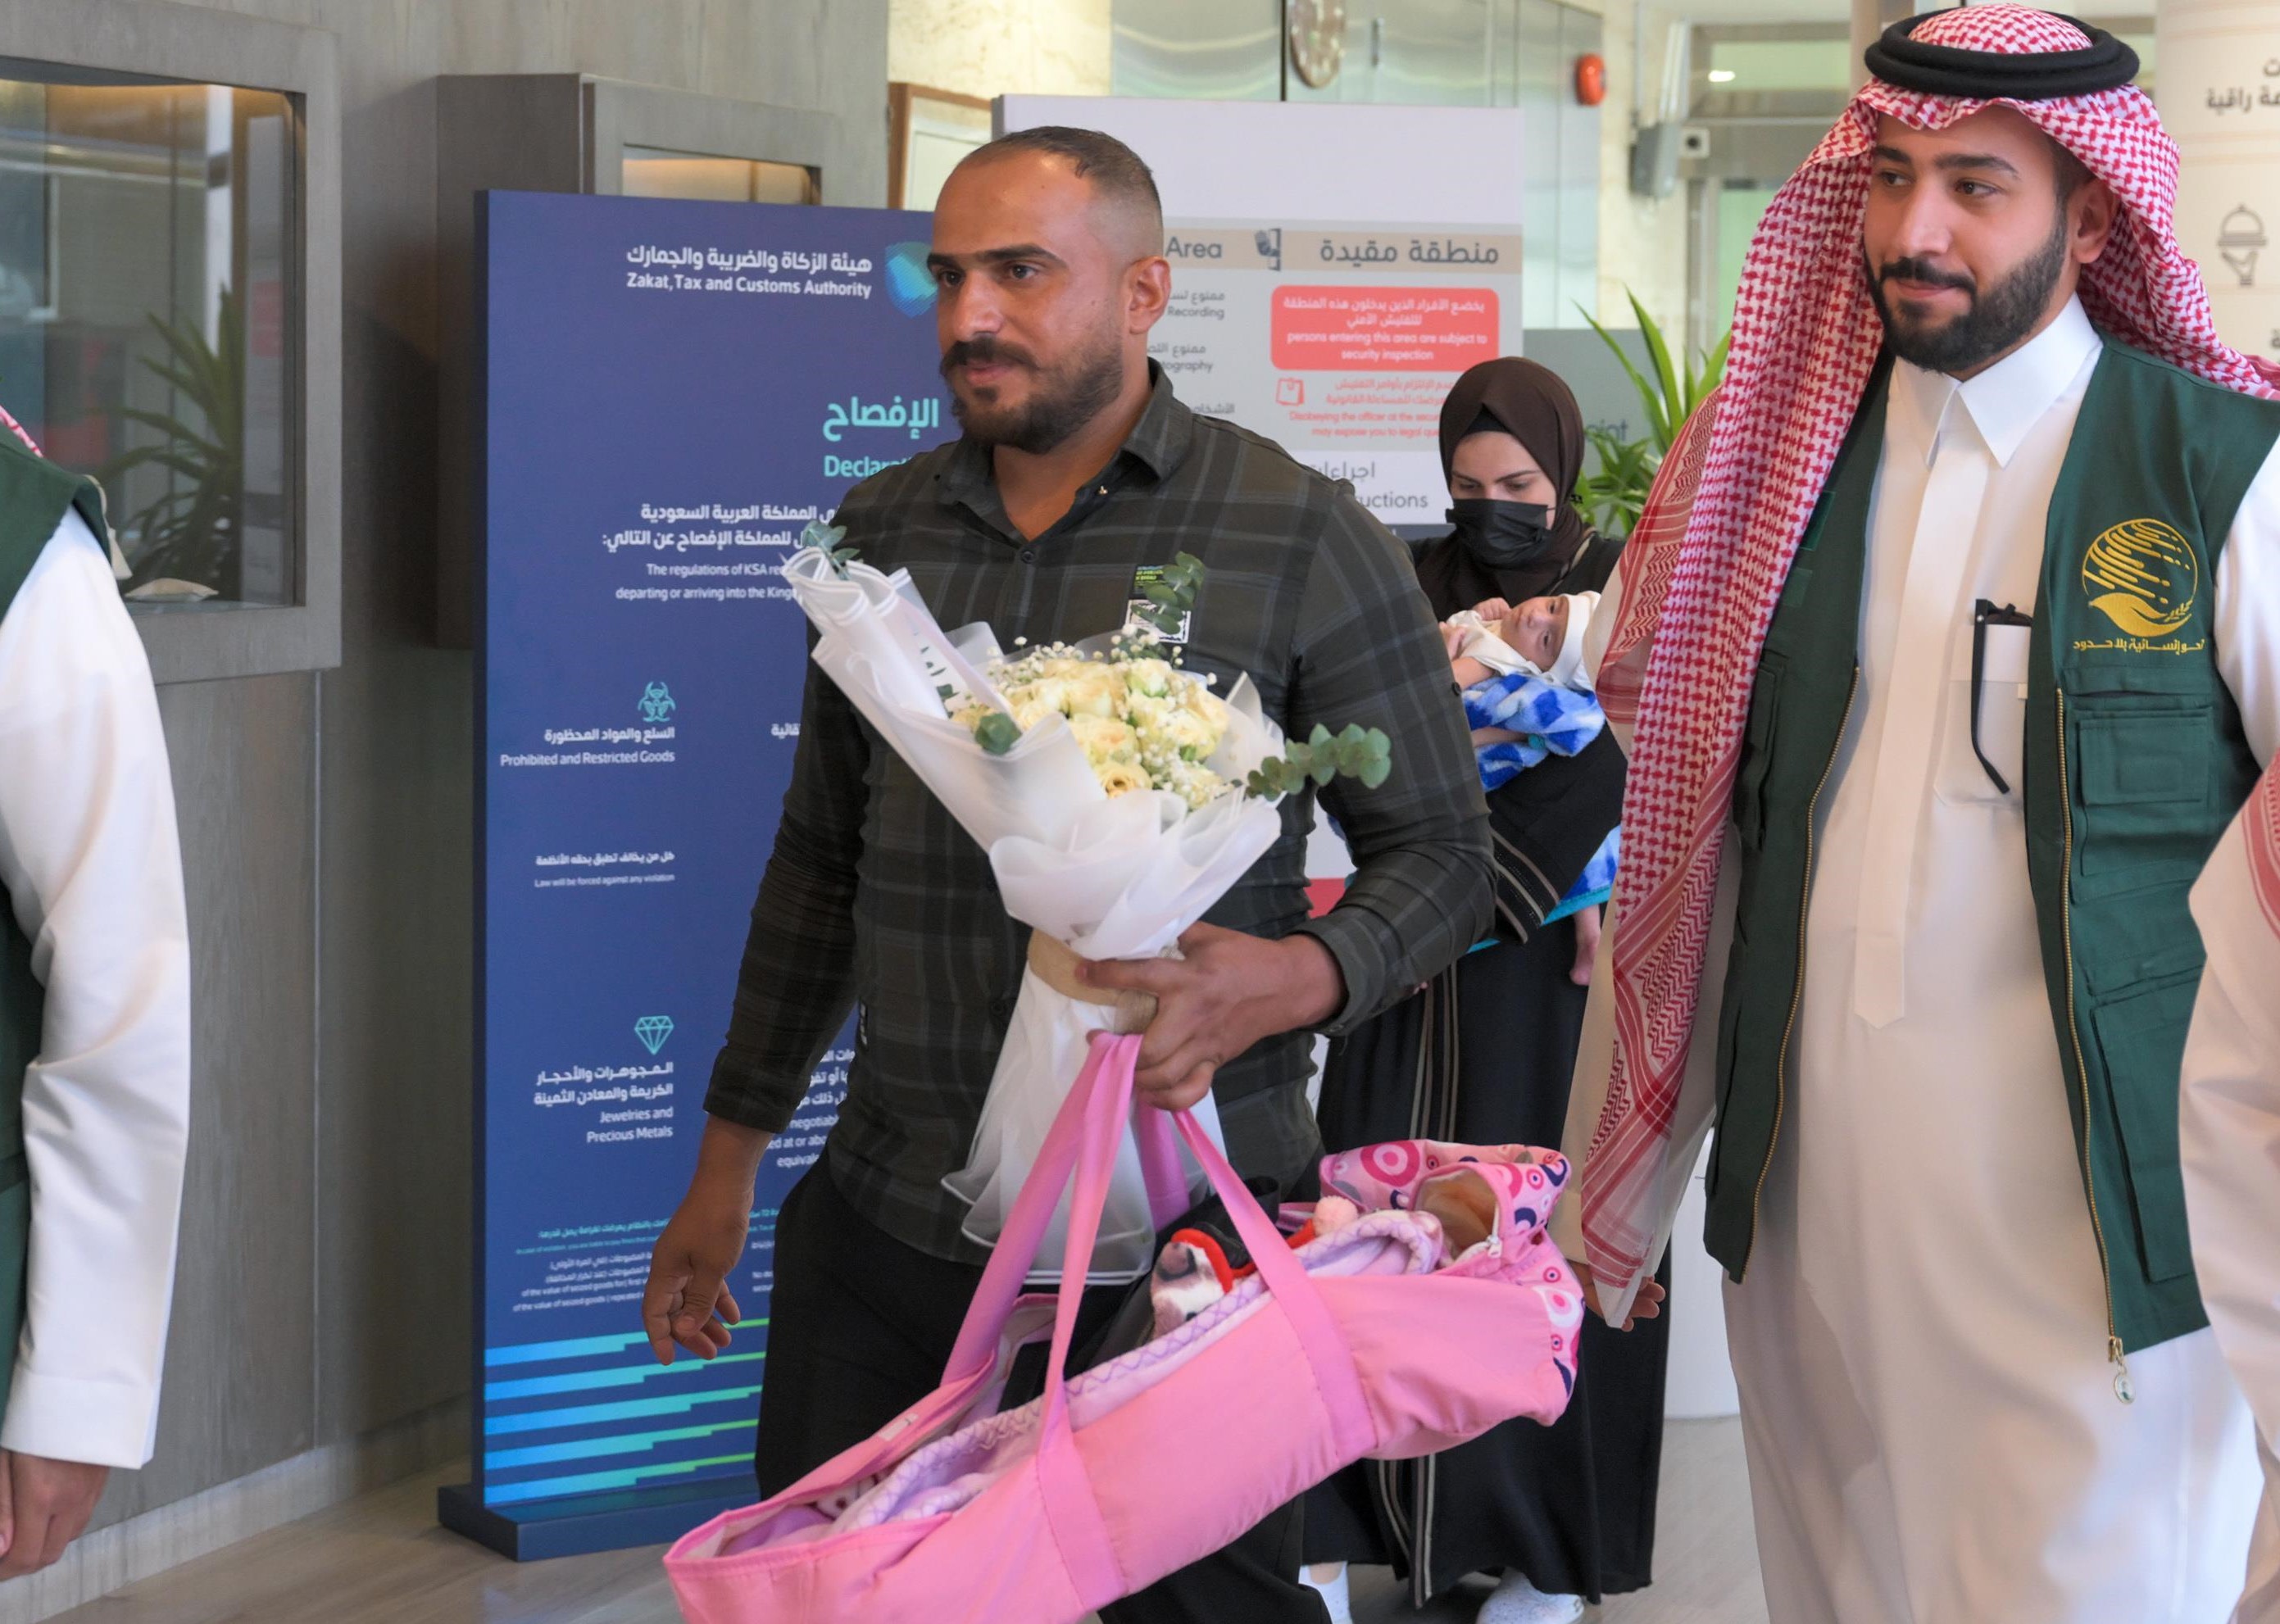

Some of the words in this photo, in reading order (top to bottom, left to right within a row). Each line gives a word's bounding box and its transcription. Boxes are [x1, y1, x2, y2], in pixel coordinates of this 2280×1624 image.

[1165, 237, 1223, 259] Area
[1319, 239, 1398, 267] مقيدة
[1408, 238, 1500, 265] منطقة
[626, 245, 703, 270] والجمارك
[706, 247, 779, 274] والضريبة
[781, 252, 827, 274] الزكاة
[830, 252, 873, 276] هيئة
[626, 272, 673, 292] Zakat,
[674, 274, 702, 291] Tax
[705, 276, 734, 292] and
[735, 277, 802, 294] Customs
[803, 280, 872, 300] Authority
[1167, 306, 1225, 320] Recording
[1287, 333, 1327, 344] persons
[1328, 332, 1371, 346] entering
[1373, 332, 1391, 343] this
[1393, 333, 1417, 343] area
[1419, 333, 1437, 343] are
[1438, 333, 1474, 347] subject
[1476, 334, 1487, 344] to
[1342, 349, 1380, 362] security
[1382, 350, 1434, 362] inspection
[823, 396, 939, 442] الإفصاح
[640, 503, 710, 524] السعودية
[711, 503, 760, 524] العربية
[762, 504, 818, 521] المملكة
[602, 529, 652, 553] التالي:
[653, 532, 675, 551] عن
[676, 529, 733, 552] الإفصاح
[734, 530, 792, 546] للمملكة
[646, 563, 667, 576] The
[669, 563, 730, 578] regulations
[731, 563, 743, 576] of
[744, 563, 768, 576] KSA
[615, 587, 668, 601] departing
[670, 588, 682, 599] or
[683, 587, 726, 601] arriving
[726, 587, 747, 599] into
[747, 587, 765, 599] the
[2073, 639, 2113, 651] حدود
[544, 728, 599, 746] المحظورة
[601, 728, 642, 744] والمواد
[643, 727, 675, 745] السلع
[500, 754, 558, 767] Prohibited
[560, 752, 581, 765] and
[583, 751, 638, 765] Restricted
[640, 751, 675, 763] Goods
[534, 878, 552, 887] Law
[566, 878, 577, 887] be
[535, 1065, 593, 1086] والأحجار
[594, 1061, 674, 1081] المجوهرات
[534, 1089, 575, 1107] الثمينة
[577, 1086, 628, 1106] والمعادن
[629, 1082, 674, 1099] الكريمة
[599, 1109, 651, 1123] Jewelries
[652, 1106, 674, 1119] and
[587, 1129, 634, 1143] Precious
[636, 1125, 673, 1139] Metals
[783, 1137, 793, 1148] at
[795, 1137, 806, 1147] or
